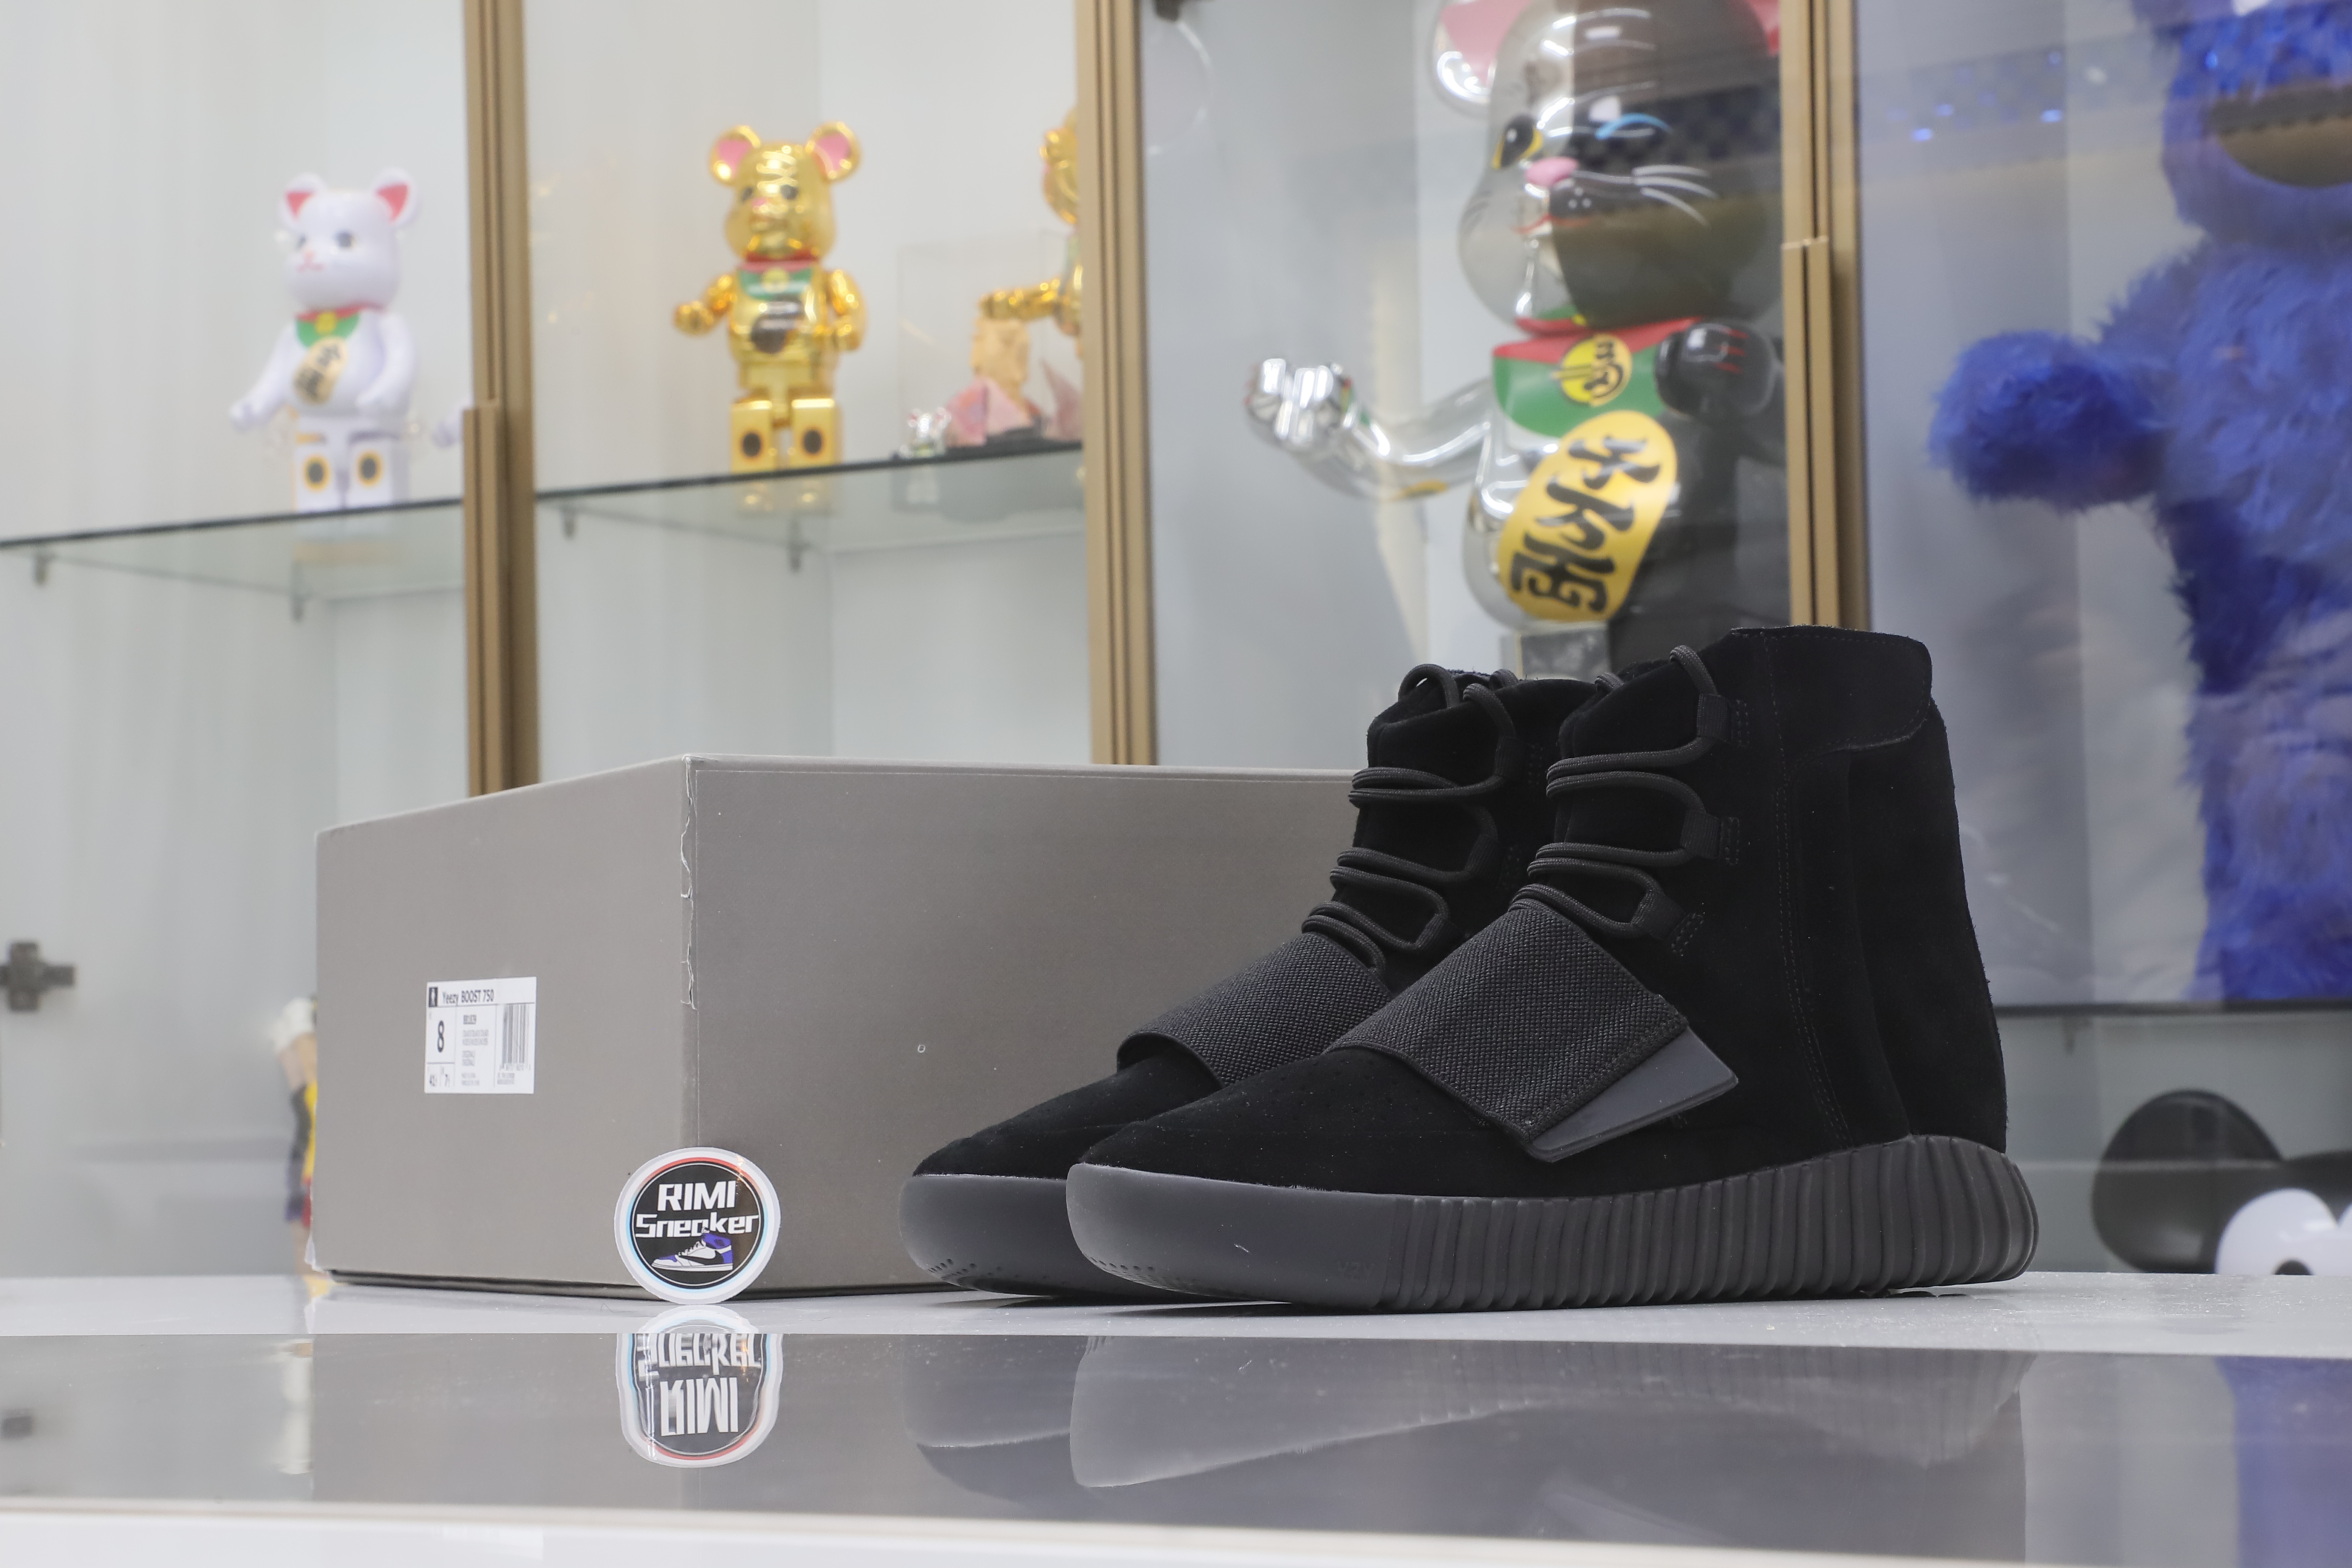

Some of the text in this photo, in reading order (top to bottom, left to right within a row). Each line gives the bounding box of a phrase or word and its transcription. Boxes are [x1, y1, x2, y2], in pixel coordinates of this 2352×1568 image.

[442, 988, 495, 1006] Yeezy BOOST 750
[438, 1020, 444, 1053] 8
[657, 1180, 736, 1211] RIMI
